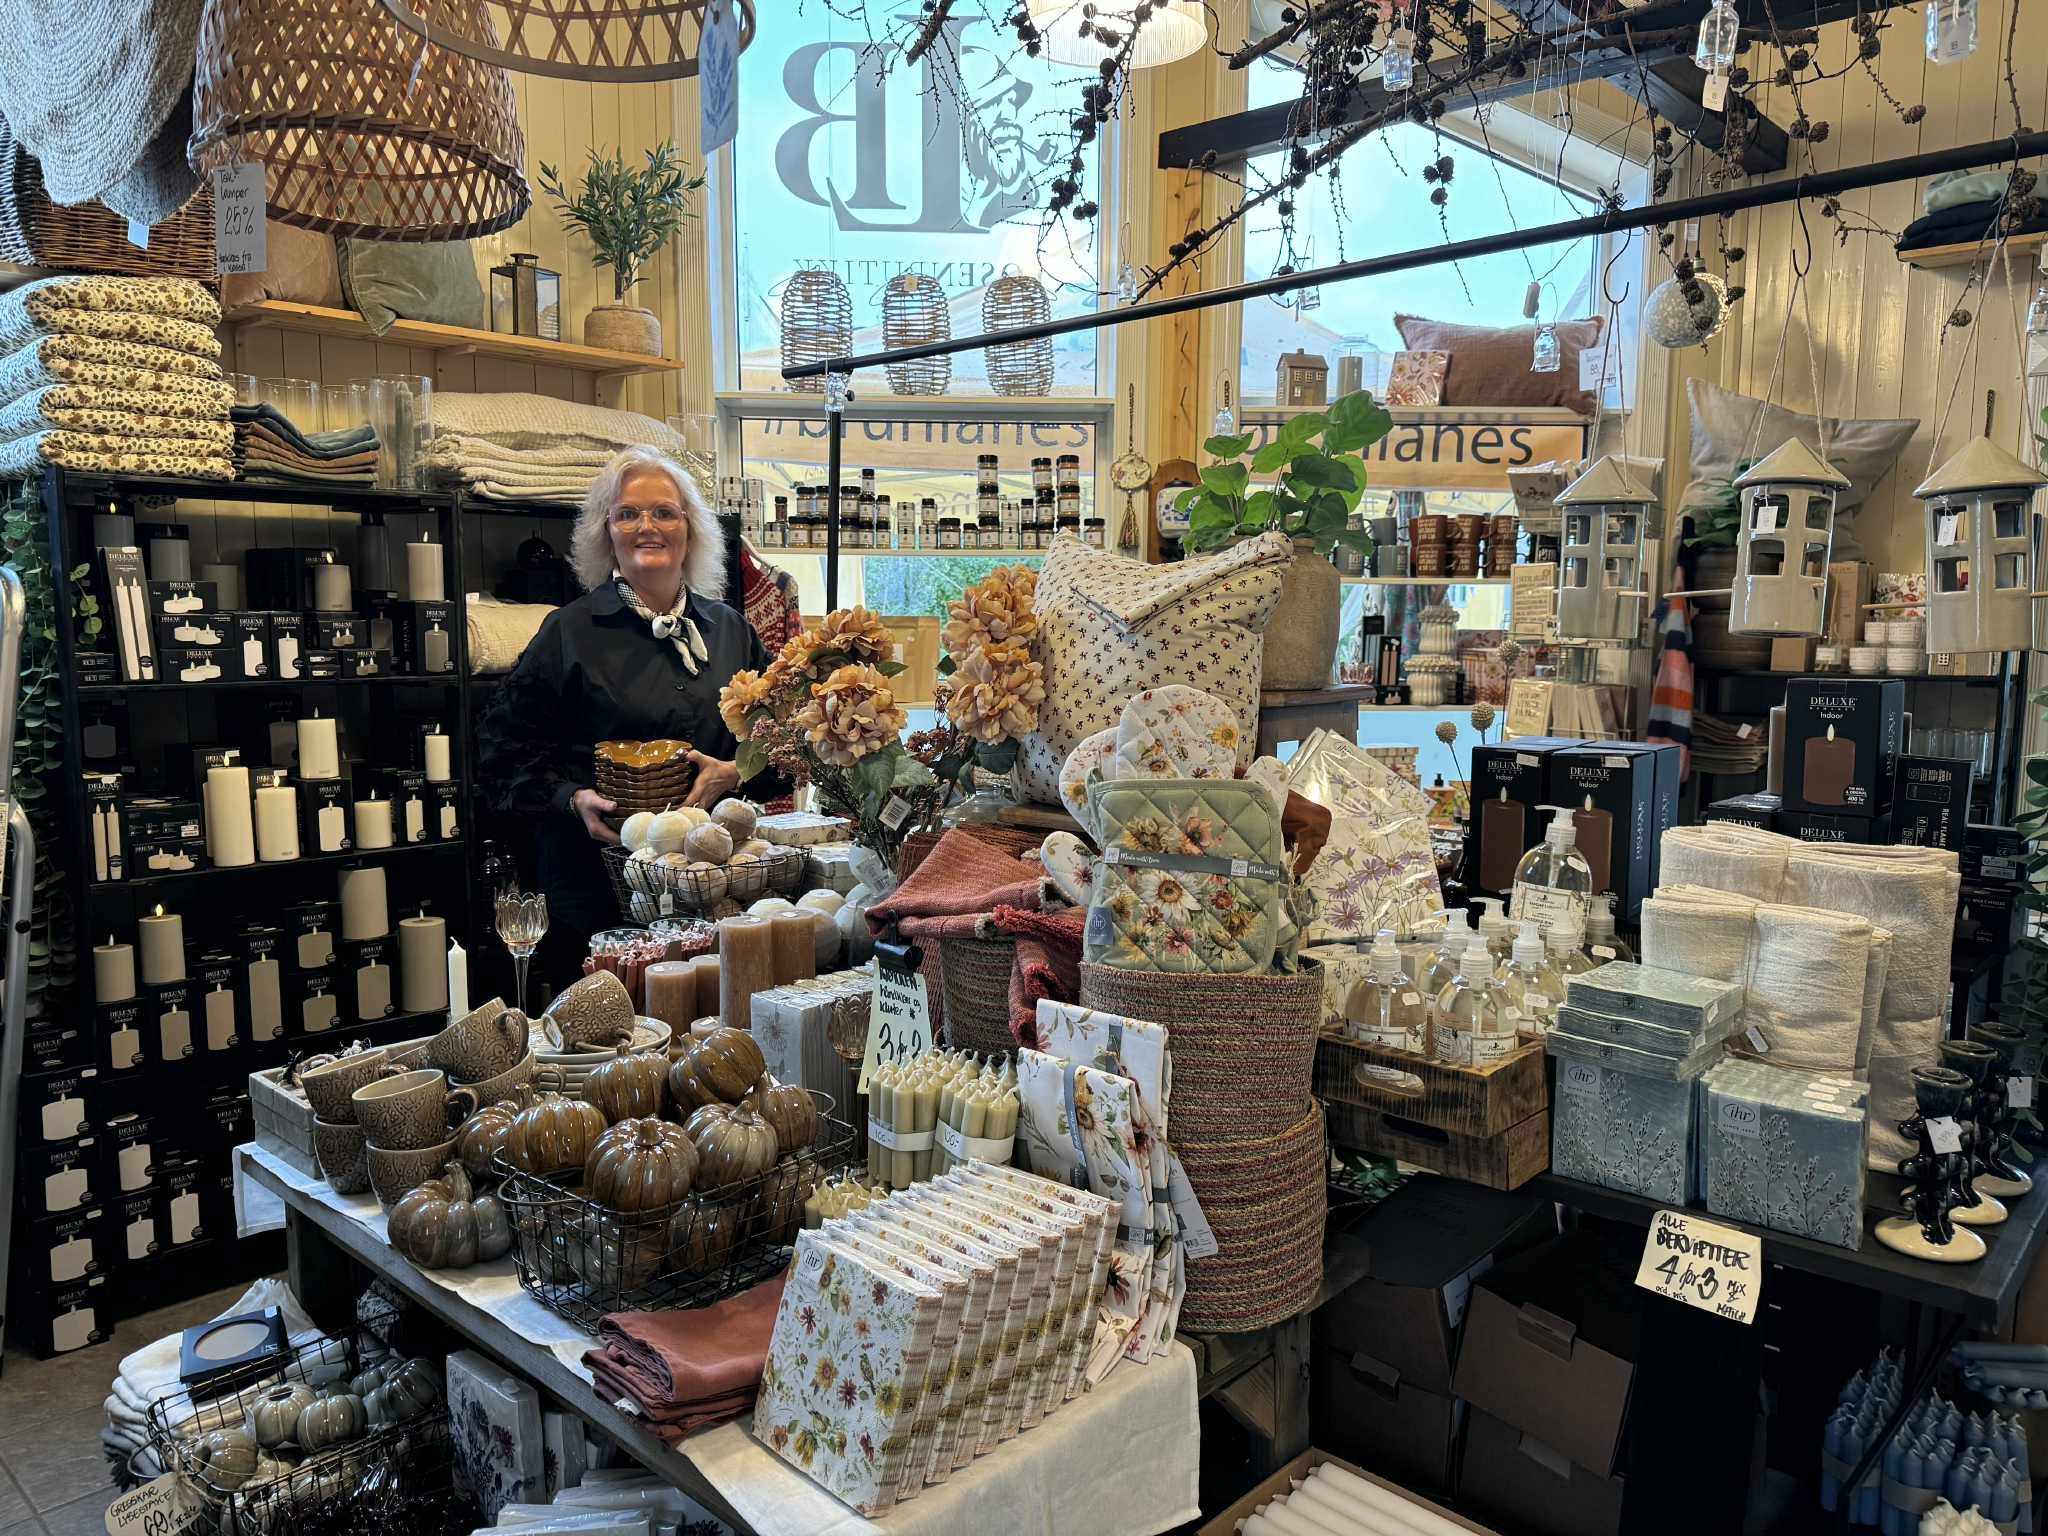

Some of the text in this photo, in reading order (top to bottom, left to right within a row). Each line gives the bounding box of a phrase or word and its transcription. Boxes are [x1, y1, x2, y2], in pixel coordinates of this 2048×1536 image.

[224, 206, 256, 236] 25%
[1810, 696, 1856, 706] DELUXE
[1570, 767, 1610, 777] DELUXE
[1579, 781, 1600, 789] Indoor
[1800, 827, 1845, 839] DELUXE
[876, 1023, 894, 1065] 3
[911, 1029, 922, 1059] 2
[1730, 1104, 1751, 1120] ihr
[1658, 1213, 1688, 1232] ALLE
[1655, 1255, 1719, 1300] 4 for 3
